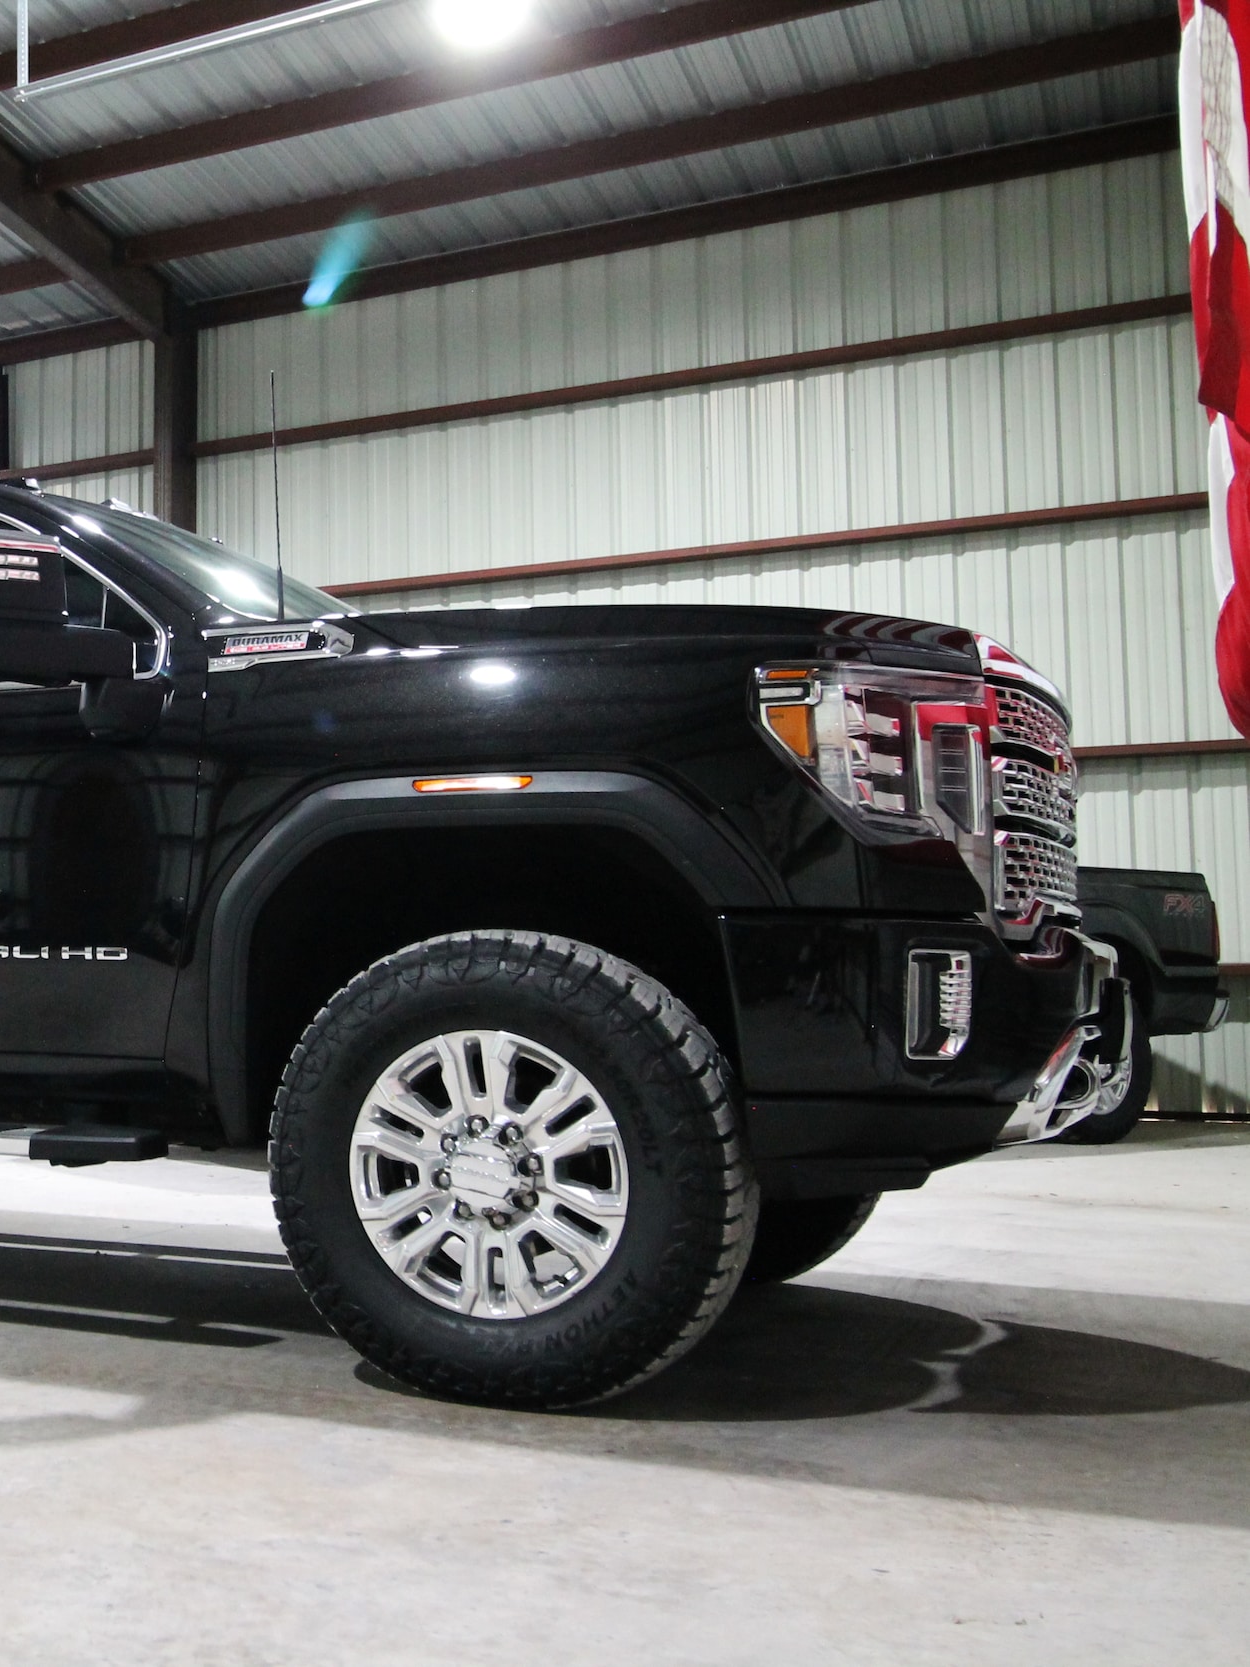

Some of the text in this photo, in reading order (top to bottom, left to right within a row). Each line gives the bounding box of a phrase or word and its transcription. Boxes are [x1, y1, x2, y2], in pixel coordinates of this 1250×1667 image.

[232, 632, 303, 647] DURAMAX
[1163, 893, 1205, 913] FX4
[61, 945, 128, 961] HD
